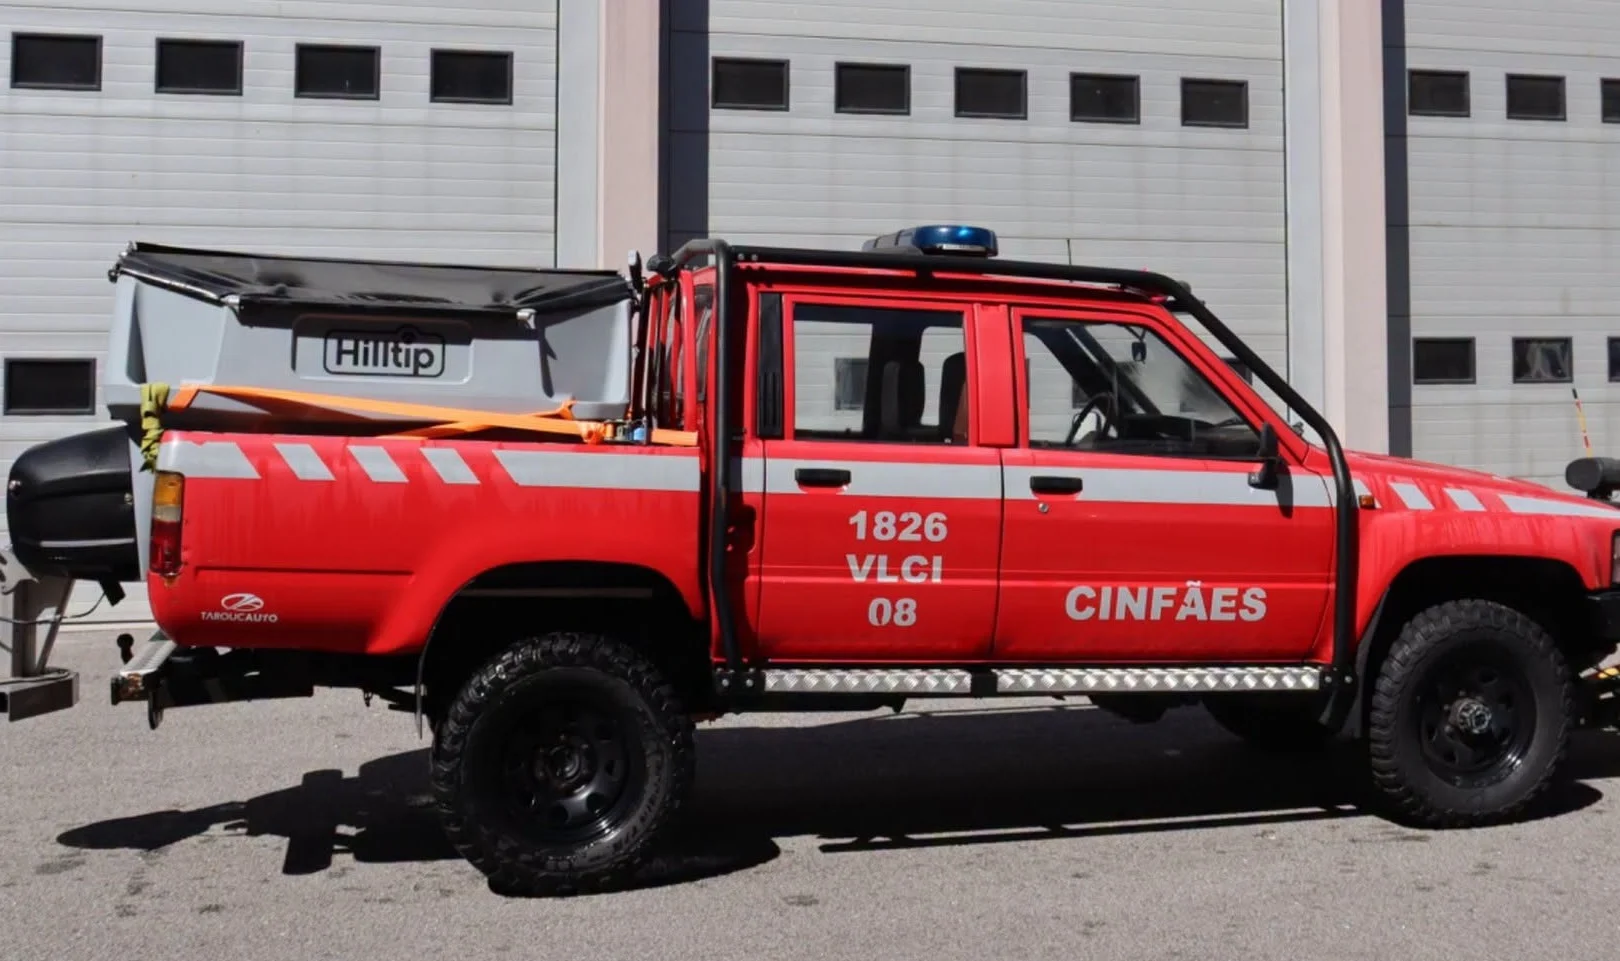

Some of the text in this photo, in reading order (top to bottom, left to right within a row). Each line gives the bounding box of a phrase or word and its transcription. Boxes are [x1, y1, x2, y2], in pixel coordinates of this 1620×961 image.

[335, 336, 435, 376] Hilltip
[849, 510, 948, 542] 1826
[845, 553, 943, 584] VLCI
[868, 597, 917, 627] 08
[1065, 580, 1267, 622] CINFÃES
